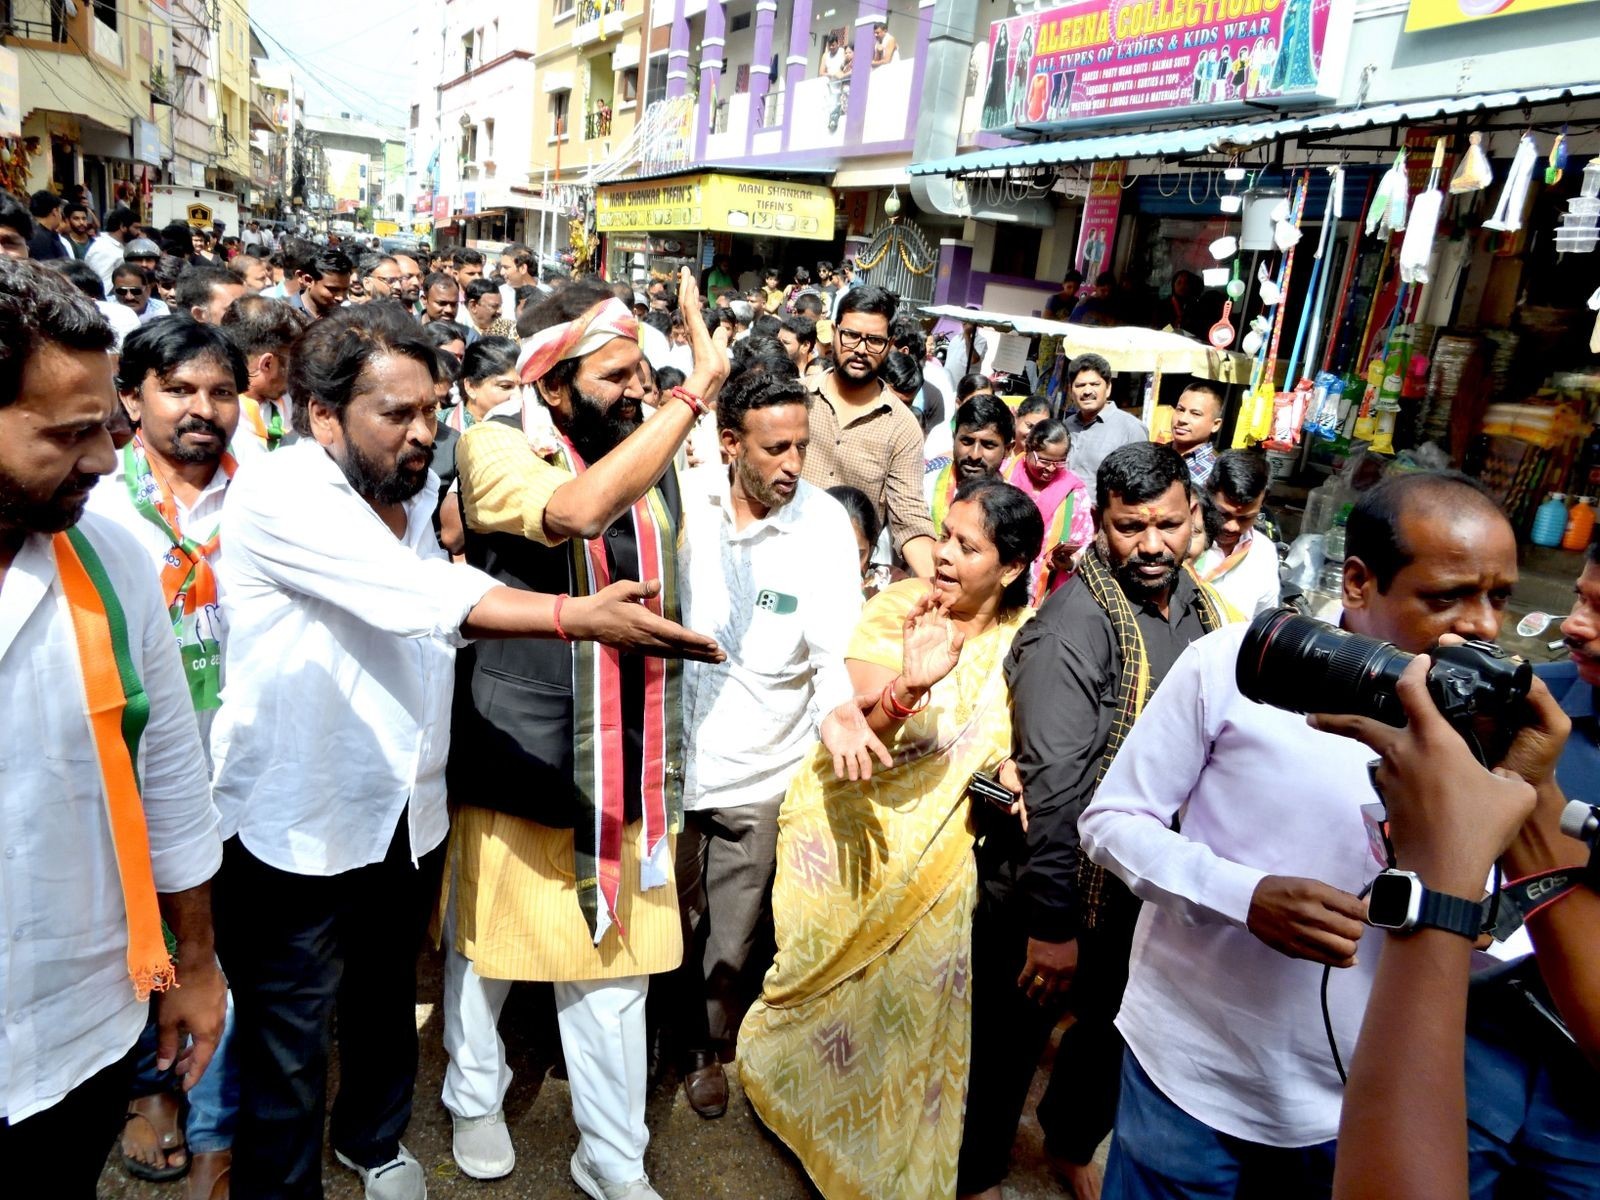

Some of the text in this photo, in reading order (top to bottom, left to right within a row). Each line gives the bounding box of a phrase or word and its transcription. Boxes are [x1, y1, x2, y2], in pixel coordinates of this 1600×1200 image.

[1035, 9, 1110, 56] ALEENA
[1036, 17, 1271, 73] ALL TYPES OF LADIES & KIDS WEAR
[1165, 73, 1180, 84] TOPS
[609, 184, 693, 208] MANI SHANKAR TIFFIN'S
[737, 183, 813, 200] MANI SHANKAR
[757, 199, 793, 212] TIFFIN'S
